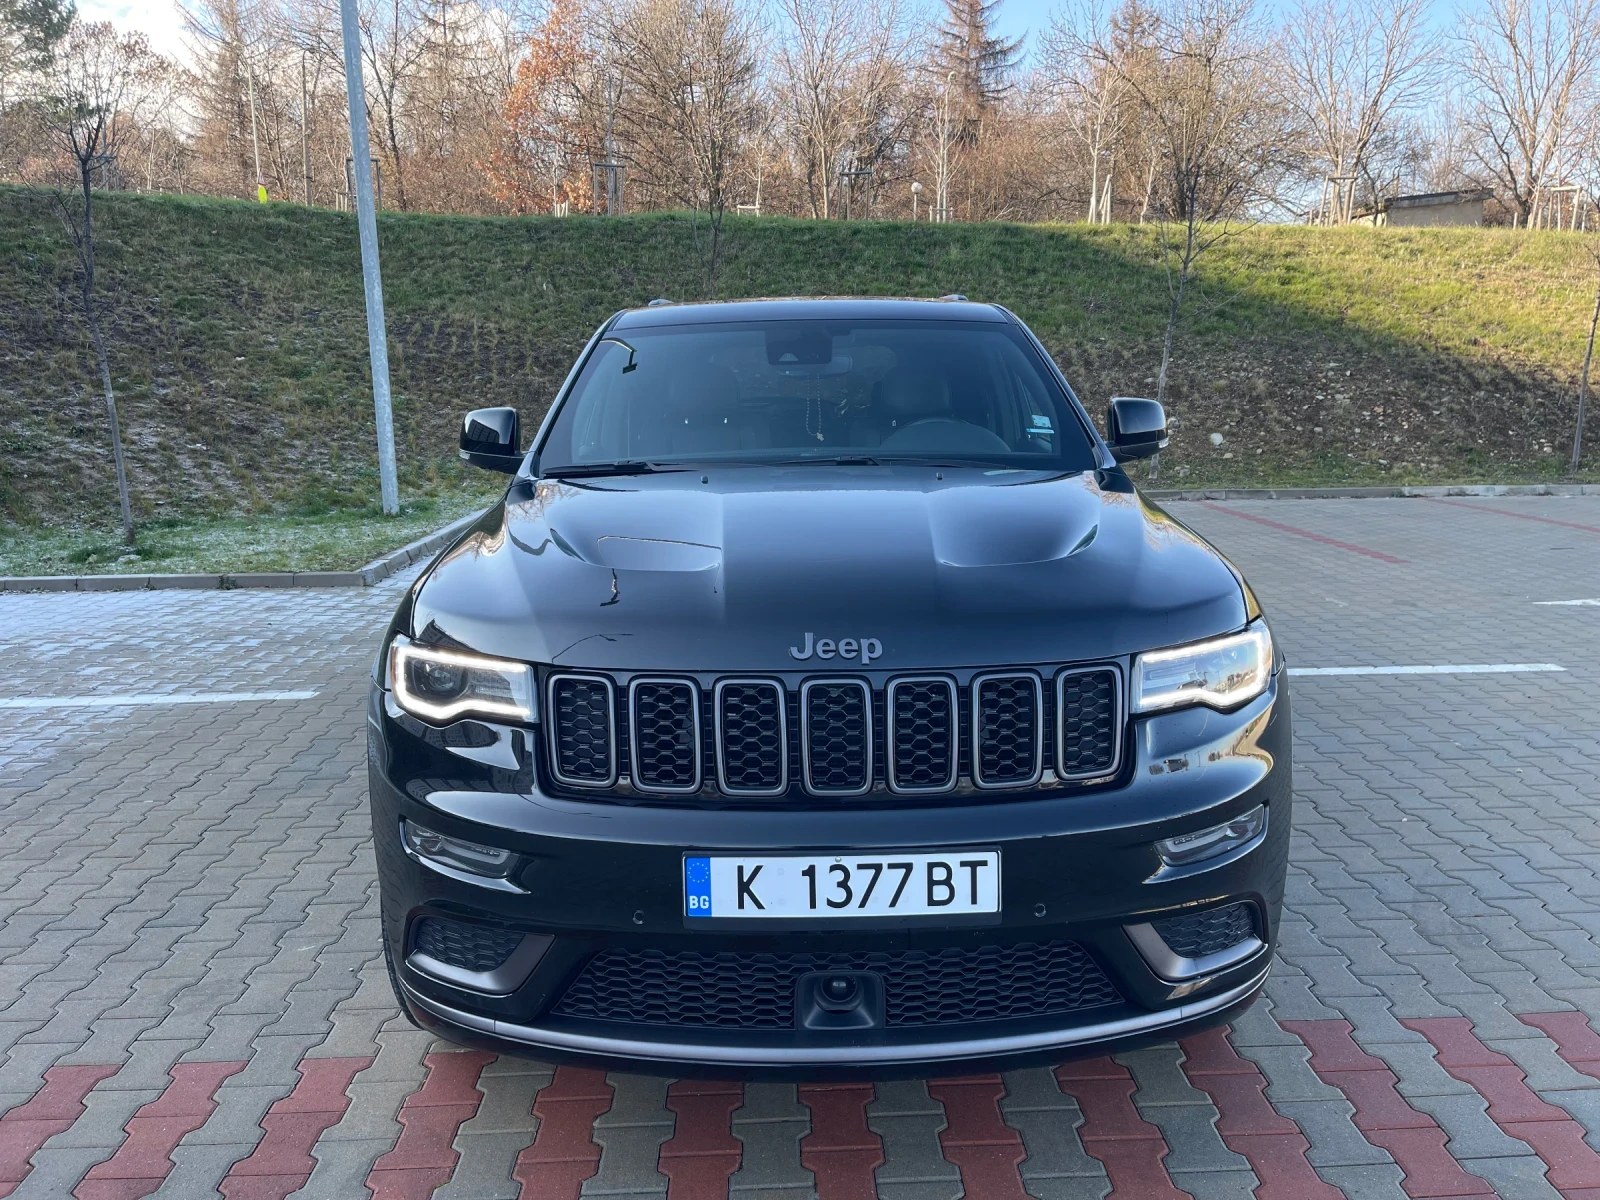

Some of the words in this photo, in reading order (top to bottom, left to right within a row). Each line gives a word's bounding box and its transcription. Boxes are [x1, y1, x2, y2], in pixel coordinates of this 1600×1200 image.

[789, 632, 883, 664] Jeep
[737, 865, 766, 909] K
[801, 862, 914, 909] 1377
[926, 860, 989, 907] BT
[689, 895, 710, 909] BG
